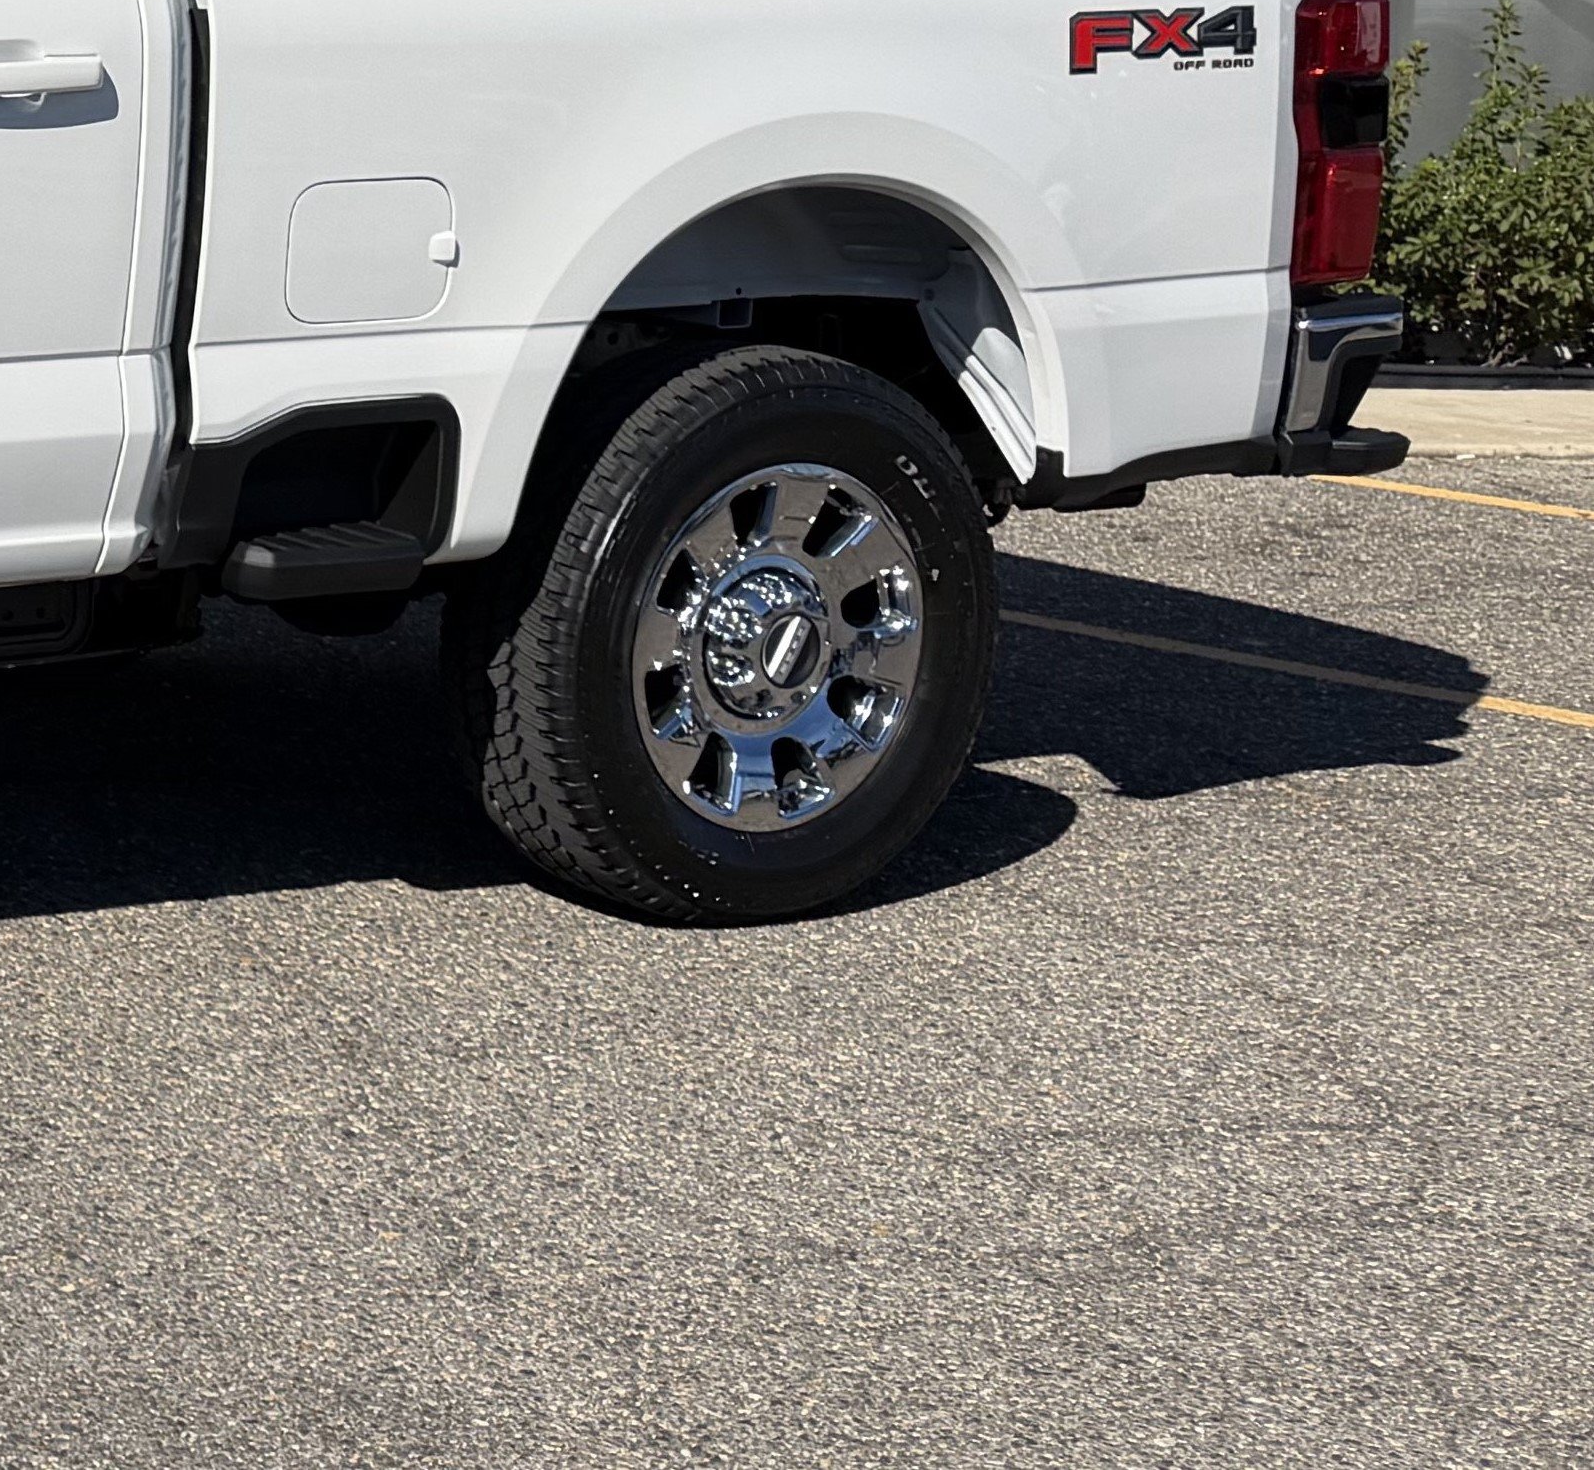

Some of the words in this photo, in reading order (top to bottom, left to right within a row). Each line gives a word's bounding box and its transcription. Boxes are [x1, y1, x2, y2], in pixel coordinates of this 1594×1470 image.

[1069, 5, 1257, 75] FX4
[1173, 60, 1206, 71] OFF
[1211, 57, 1255, 70] ROAD
